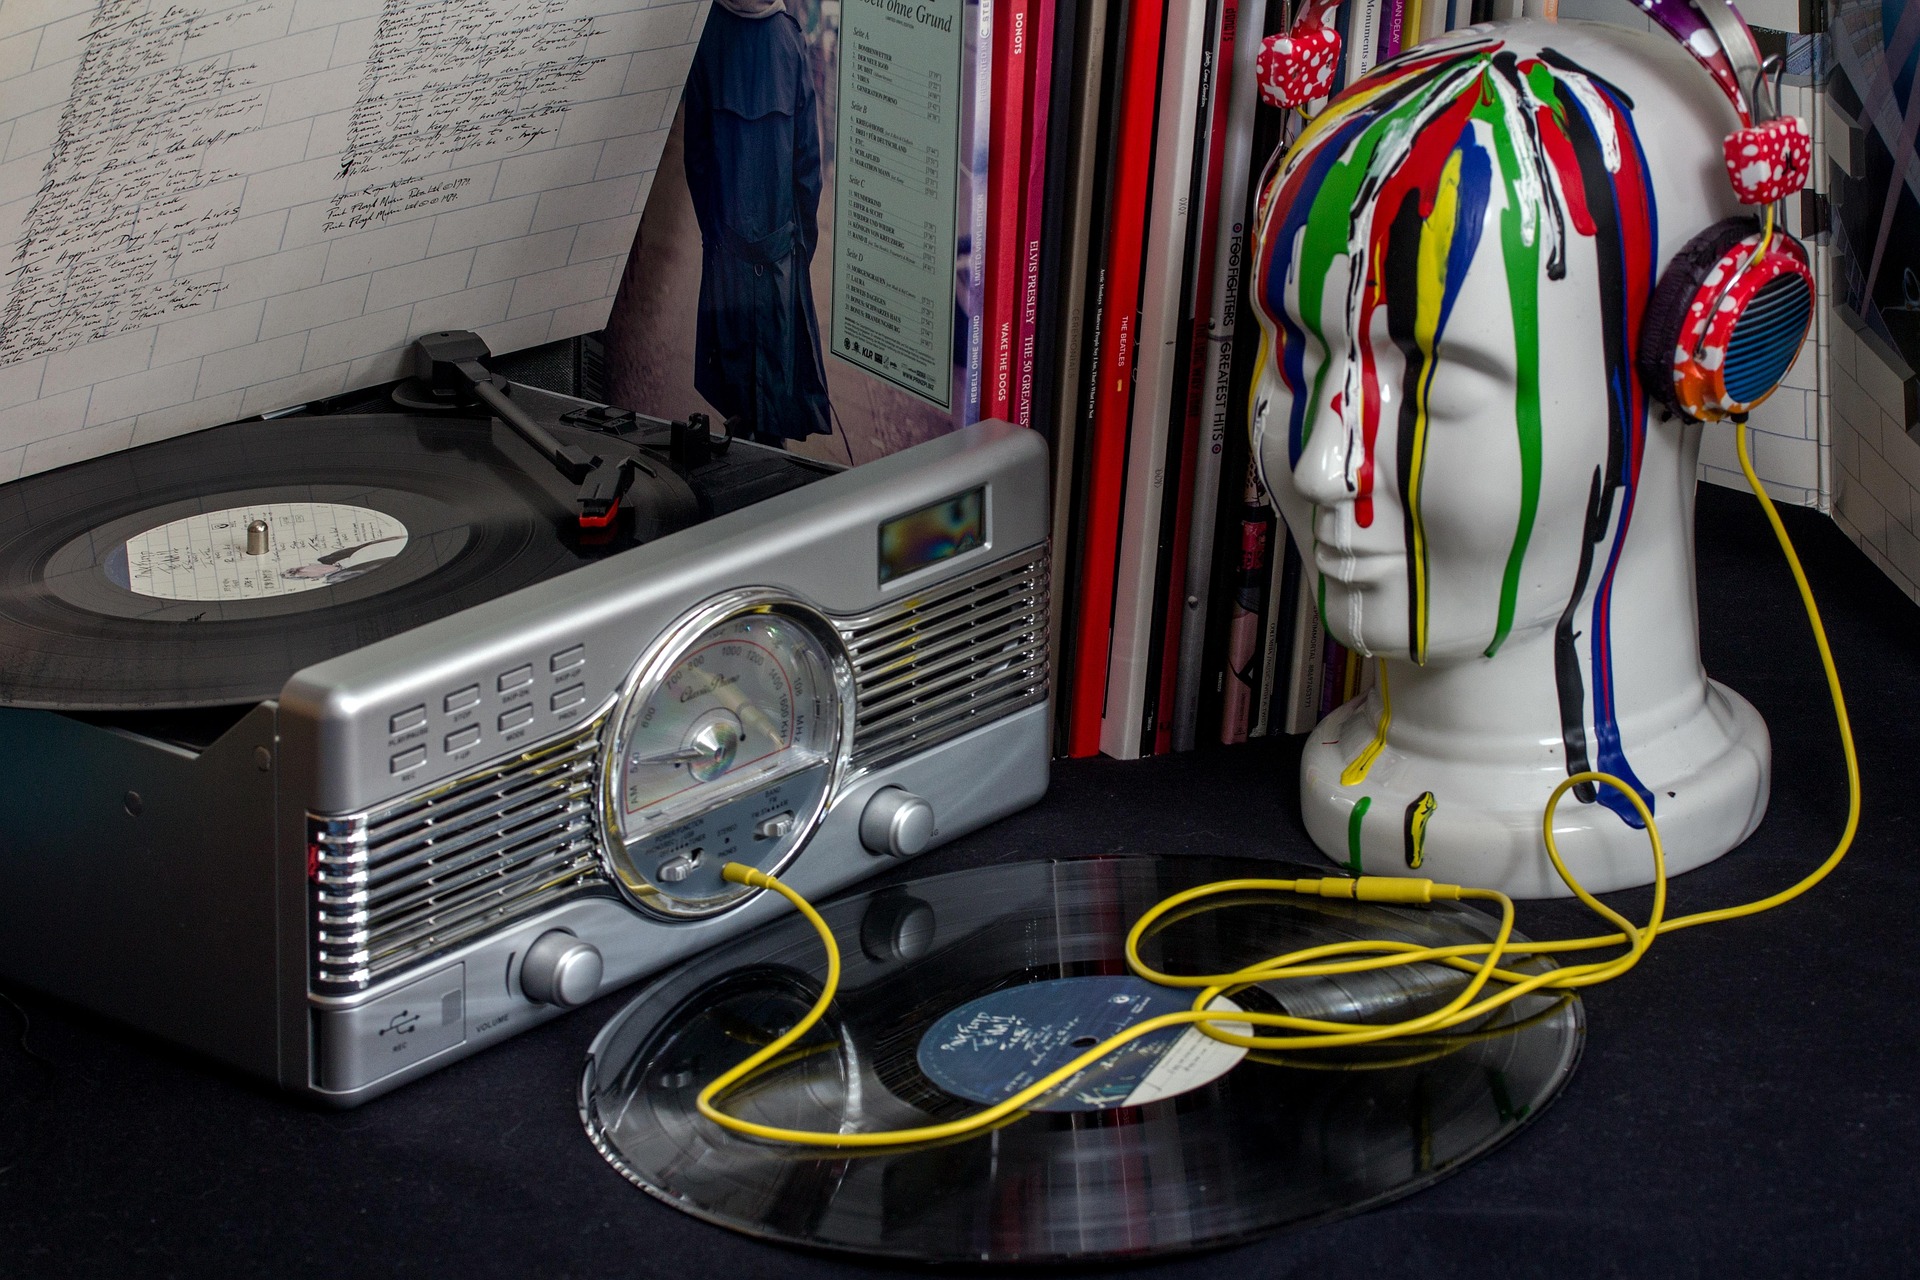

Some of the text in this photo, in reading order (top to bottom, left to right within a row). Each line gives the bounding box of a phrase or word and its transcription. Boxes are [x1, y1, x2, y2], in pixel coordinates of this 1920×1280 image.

[886, 0, 953, 33] ohne Grund
[1362, 0, 1375, 59] Monuments
[1392, 0, 1403, 44] JAN DELAY
[853, 27, 870, 40] Seite A
[1014, 13, 1024, 55] DONOTS
[851, 101, 868, 114] Seite B
[849, 174, 865, 188] Seite C
[976, 194, 984, 227] EDITION
[111, 233, 146, 249] Days
[858, 253, 864, 262] D
[974, 254, 982, 287] LIMITED
[1019, 240, 1039, 429] ELVIS PRESLEY THE 50 GREATES
[1120, 315, 1129, 331] THE
[1212, 236, 1242, 441] FOO FIGHTERS GREATEST HITS
[862, 347, 874, 360] KLR
[970, 315, 980, 404] REBELL OHNE GRUND
[1068, 308, 1080, 379] CEREMONIALS
[1118, 333, 1127, 367] BEATLES
[998, 322, 1009, 402] WAKE THE DOGS
[721, 646, 742, 656] 1000
[746, 651, 765, 667] 1200
[453, 711, 472, 723] STOP
[506, 729, 525, 742] MODE
[475, 1013, 509, 1033] VOLUME
